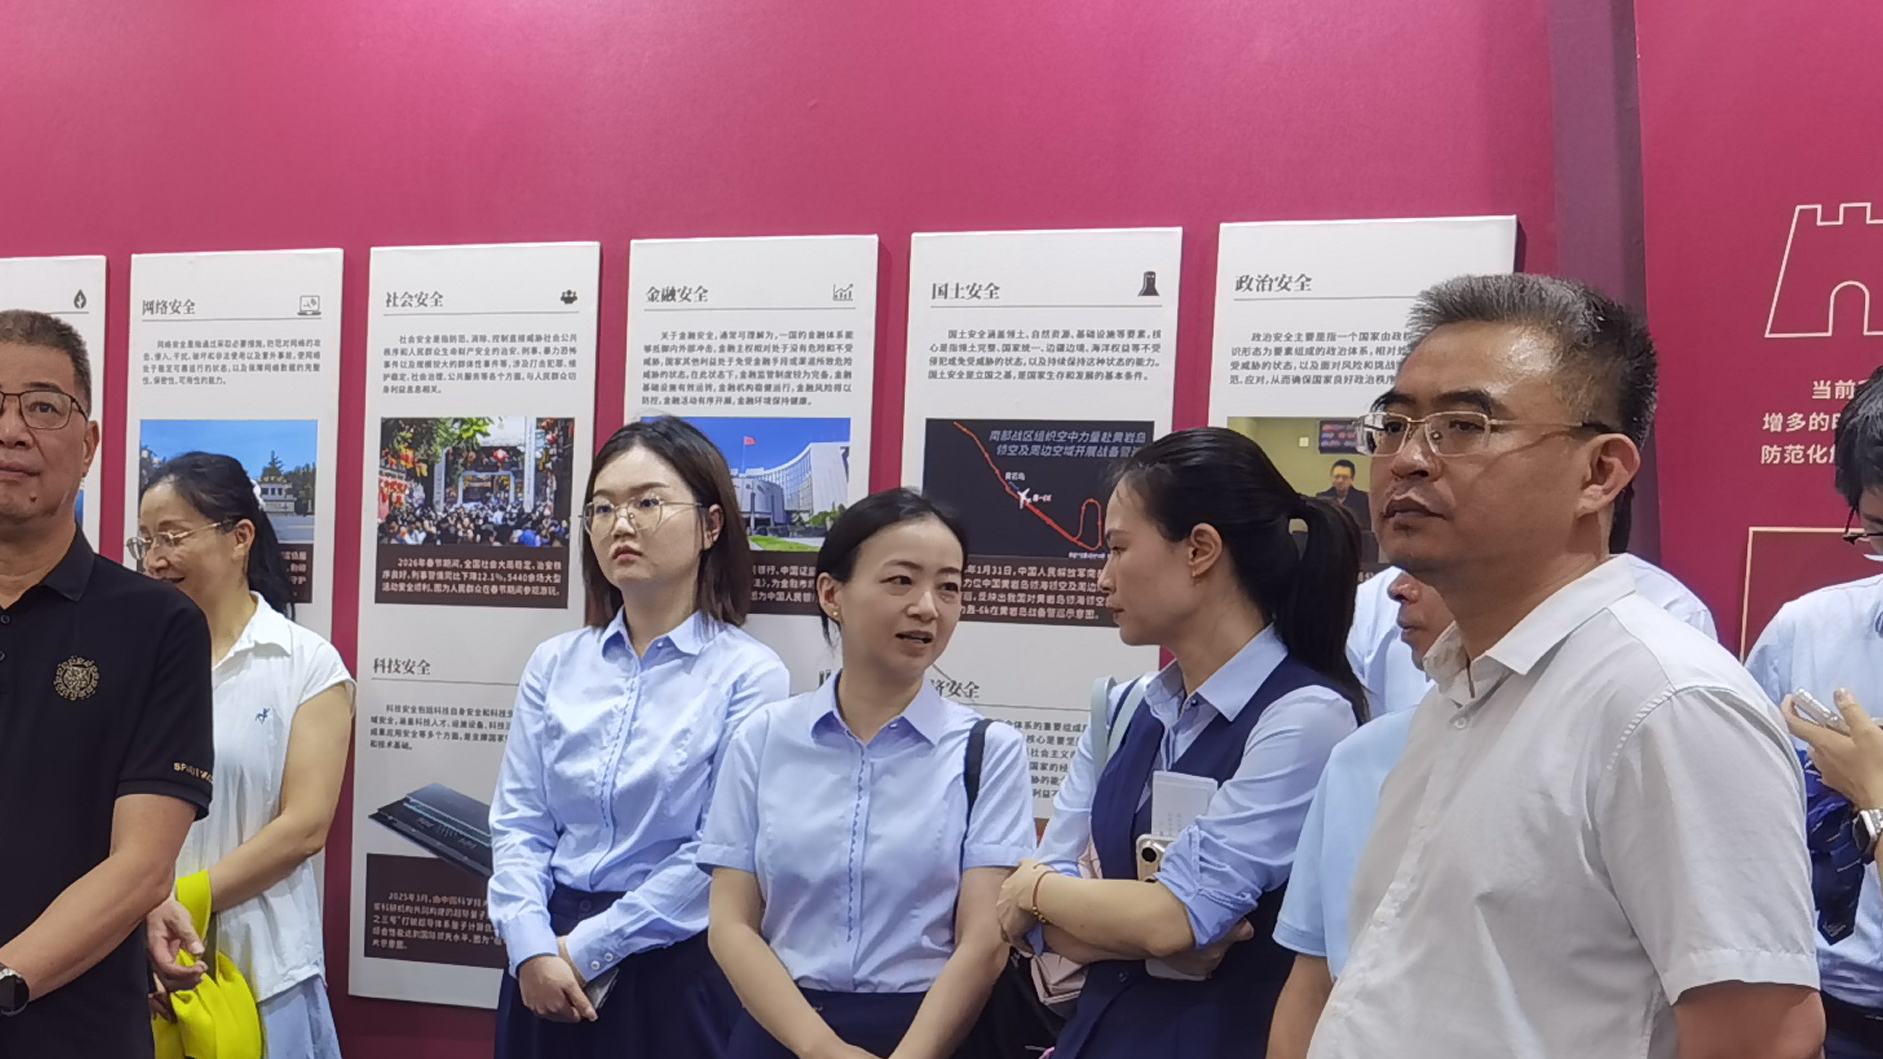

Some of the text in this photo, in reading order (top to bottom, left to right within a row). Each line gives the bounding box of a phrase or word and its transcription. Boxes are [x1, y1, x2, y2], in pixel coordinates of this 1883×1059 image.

[931, 282, 1001, 300] 国土安全
[1234, 273, 1313, 293] 政治安全
[385, 290, 444, 308] 社会安全
[645, 285, 709, 303] 金融安全
[141, 298, 196, 316] 网络安全
[1811, 379, 1868, 400] 当前
[373, 657, 431, 675] 科技安全
[1026, 735, 1079, 746] 核心是要坚
